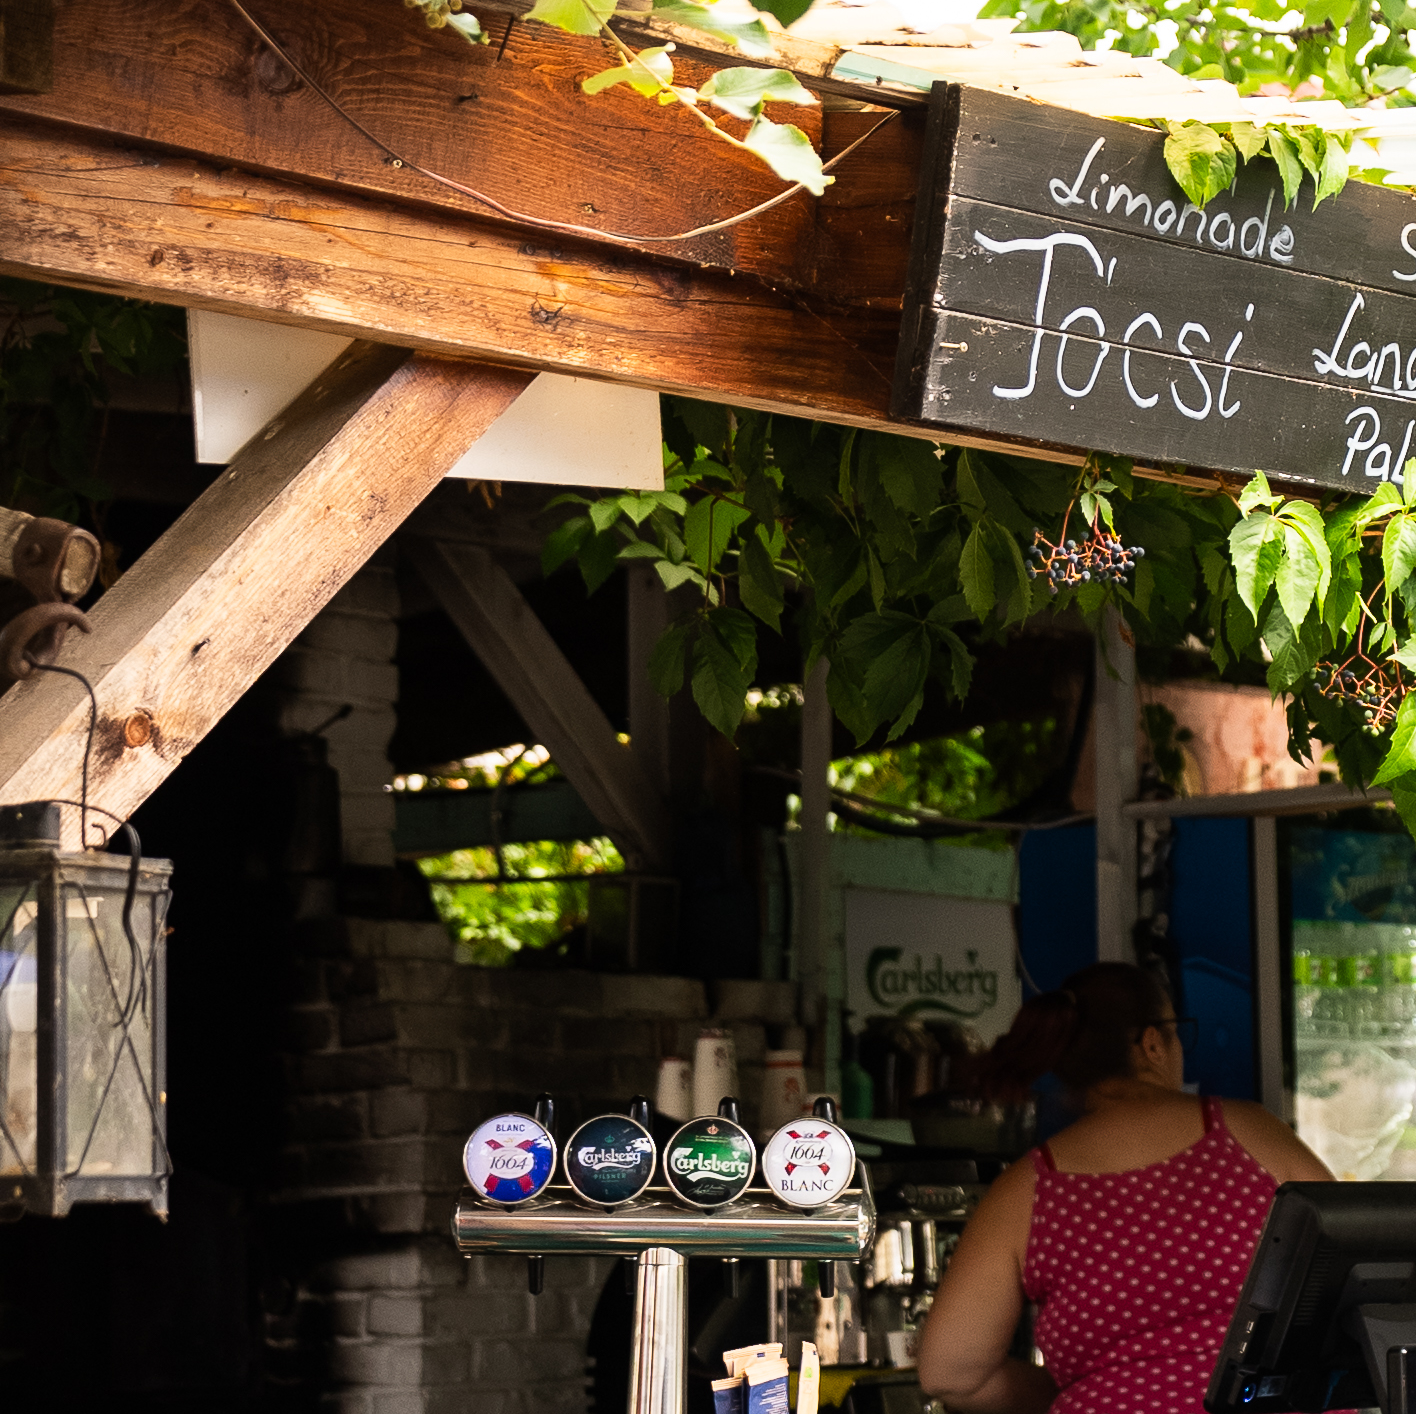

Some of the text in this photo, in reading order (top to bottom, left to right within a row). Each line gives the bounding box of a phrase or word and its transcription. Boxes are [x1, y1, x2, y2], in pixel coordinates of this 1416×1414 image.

[973, 230, 1255, 421] Tócsi
[865, 945, 999, 1012] Carlsberg
[495, 1123, 526, 1133] BLANC
[489, 1155, 529, 1170] 1664
[577, 1145, 642, 1169] Carlsberg
[789, 1144, 826, 1161] 1664
[670, 1146, 750, 1180] Carlsberg
[781, 1179, 834, 1192] BLANC
